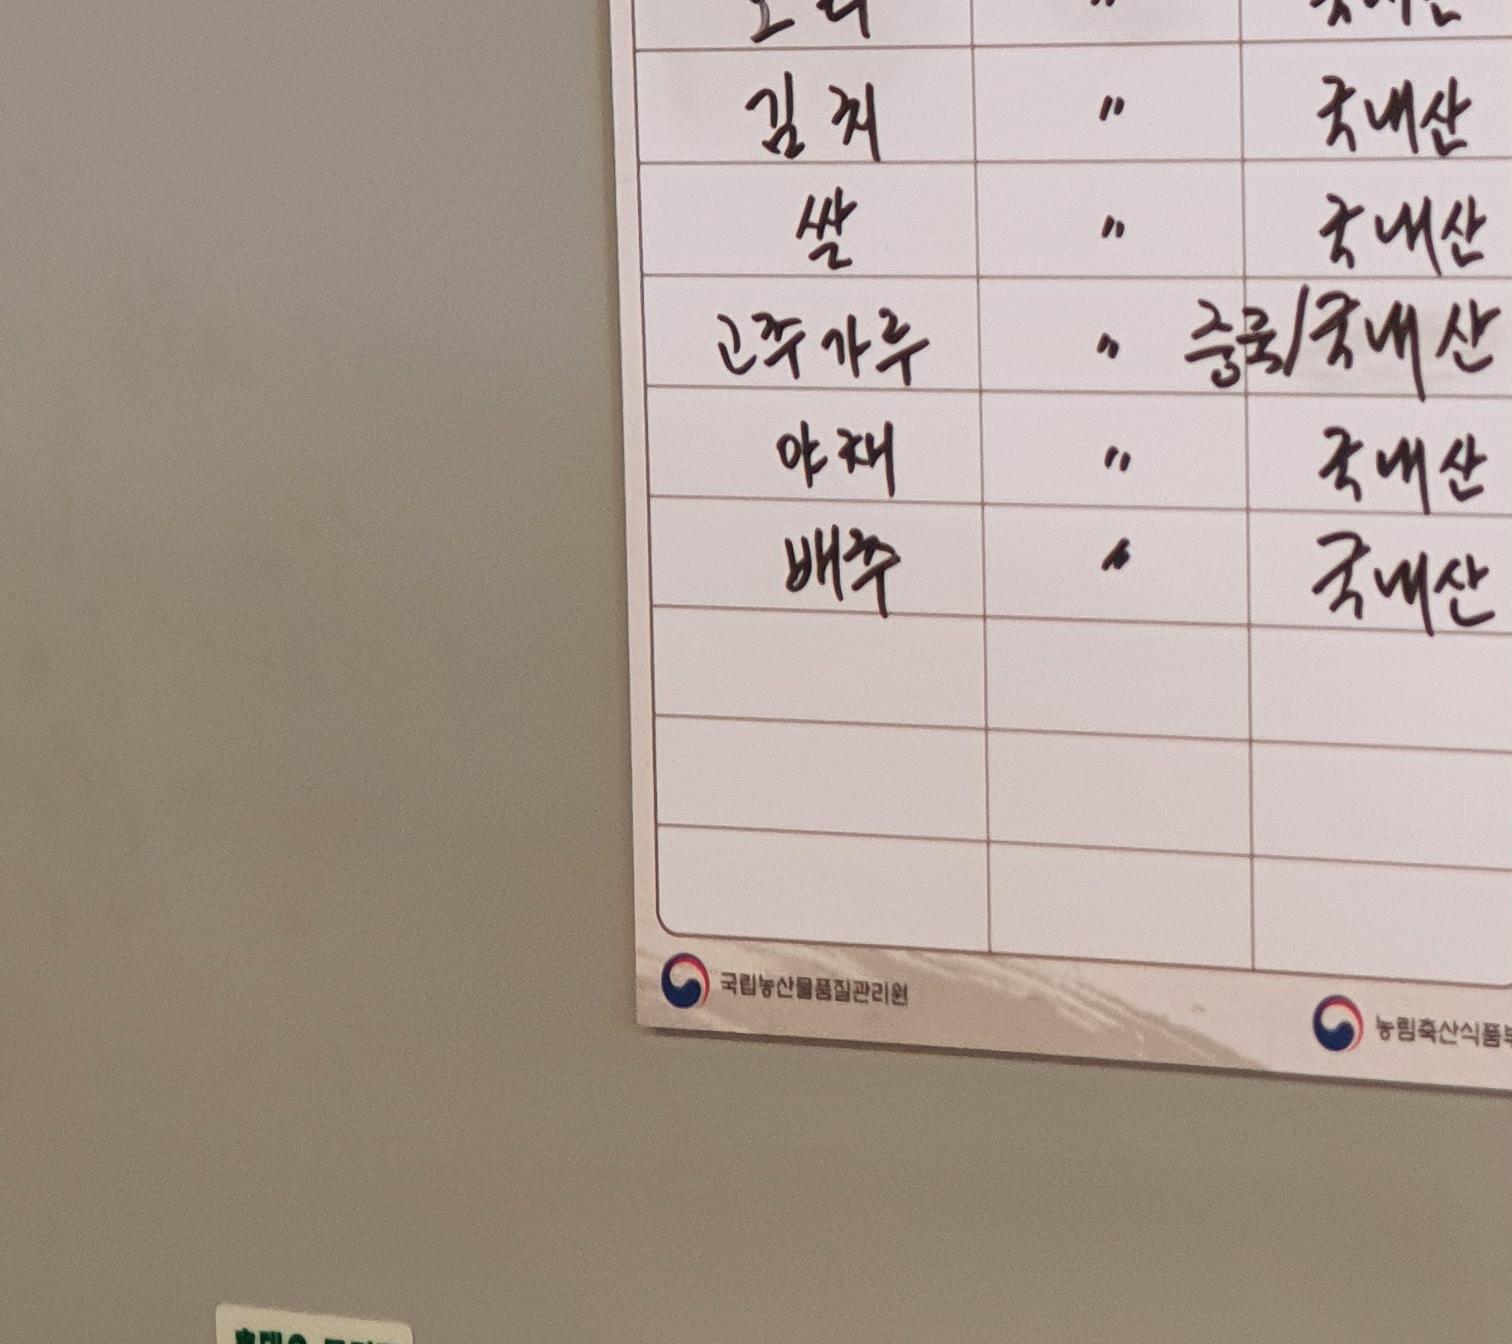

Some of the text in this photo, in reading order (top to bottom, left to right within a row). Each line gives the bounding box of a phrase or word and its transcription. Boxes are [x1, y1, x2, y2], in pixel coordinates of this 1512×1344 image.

[1317, 75, 1472, 158] 국내산
[795, 186, 858, 270] 쌀
[1319, 194, 1487, 277] 국내산
[776, 420, 895, 498] 야채
[1319, 426, 1487, 516] 국내산
[784, 524, 901, 619] 배추
[1312, 531, 1495, 637] 국내산
[720, 972, 909, 1007] 국립농산물품질관리원
